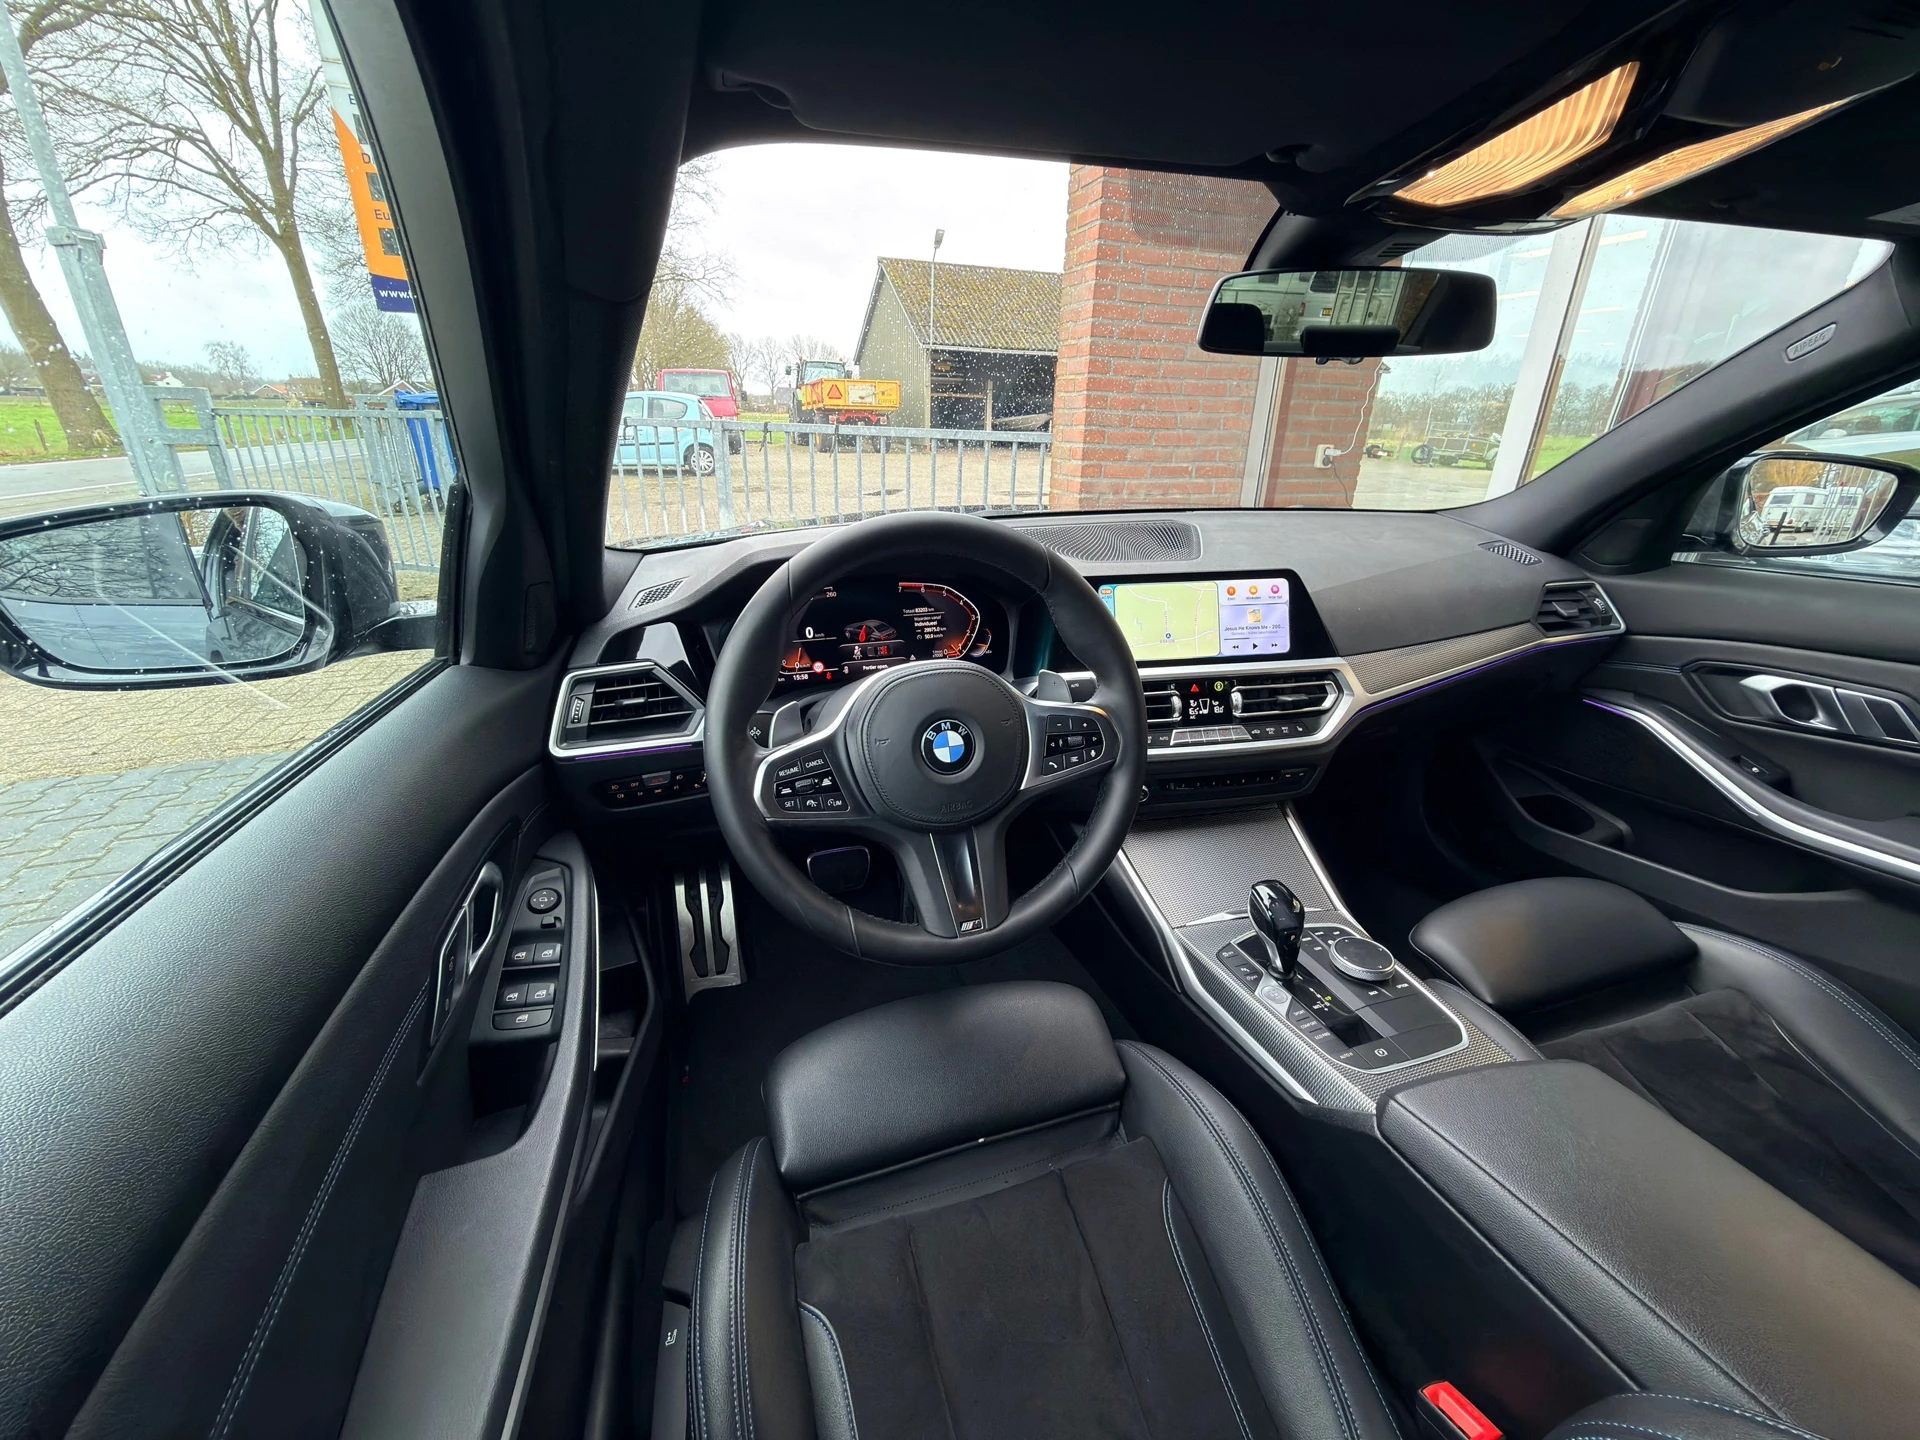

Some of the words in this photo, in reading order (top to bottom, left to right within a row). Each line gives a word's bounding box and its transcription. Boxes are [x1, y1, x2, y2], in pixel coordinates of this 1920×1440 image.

[806, 626, 814, 638] 0
[927, 722, 967, 740] BMW
[805, 758, 824, 769] CANCEL
[778, 766, 800, 777] RESUME
[1300, 1021, 1317, 1029] COMFORT
